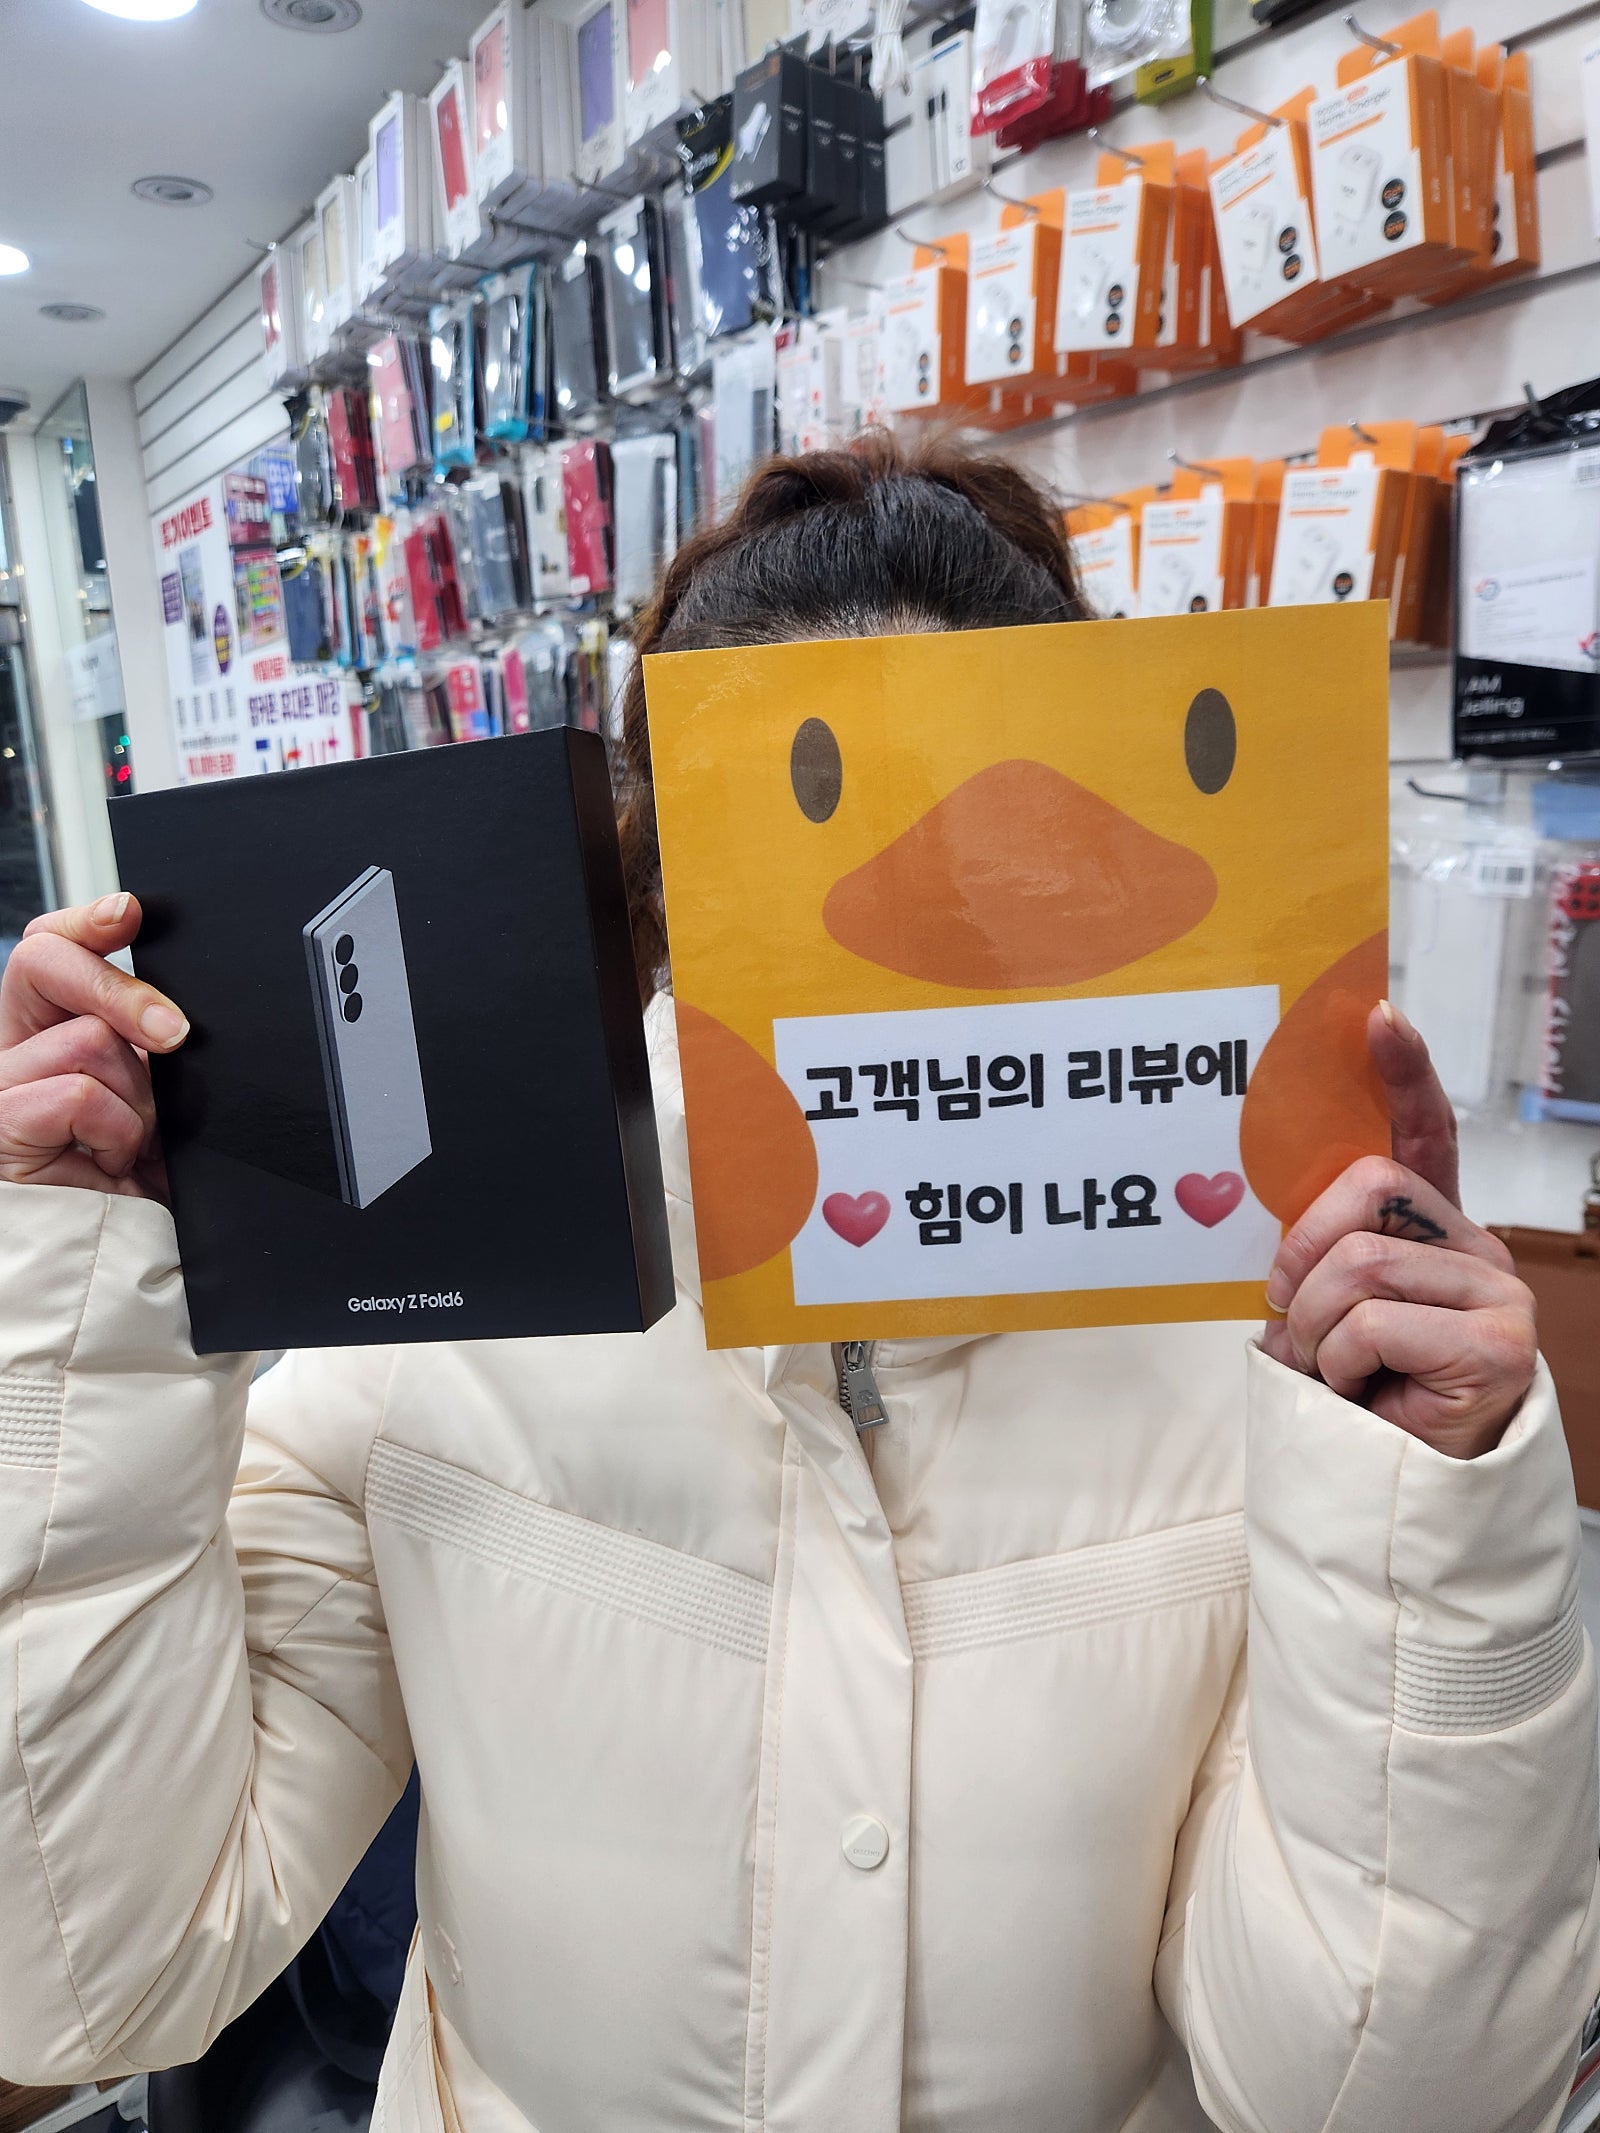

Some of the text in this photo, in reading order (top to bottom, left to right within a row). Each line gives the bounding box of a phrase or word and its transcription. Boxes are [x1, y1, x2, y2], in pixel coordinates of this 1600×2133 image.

[804, 1039, 1248, 1122] 고객님의 리뷰에
[904, 1174, 1162, 1246] 힘이 나요
[347, 1291, 464, 1314] Galaxy Z Fold6
